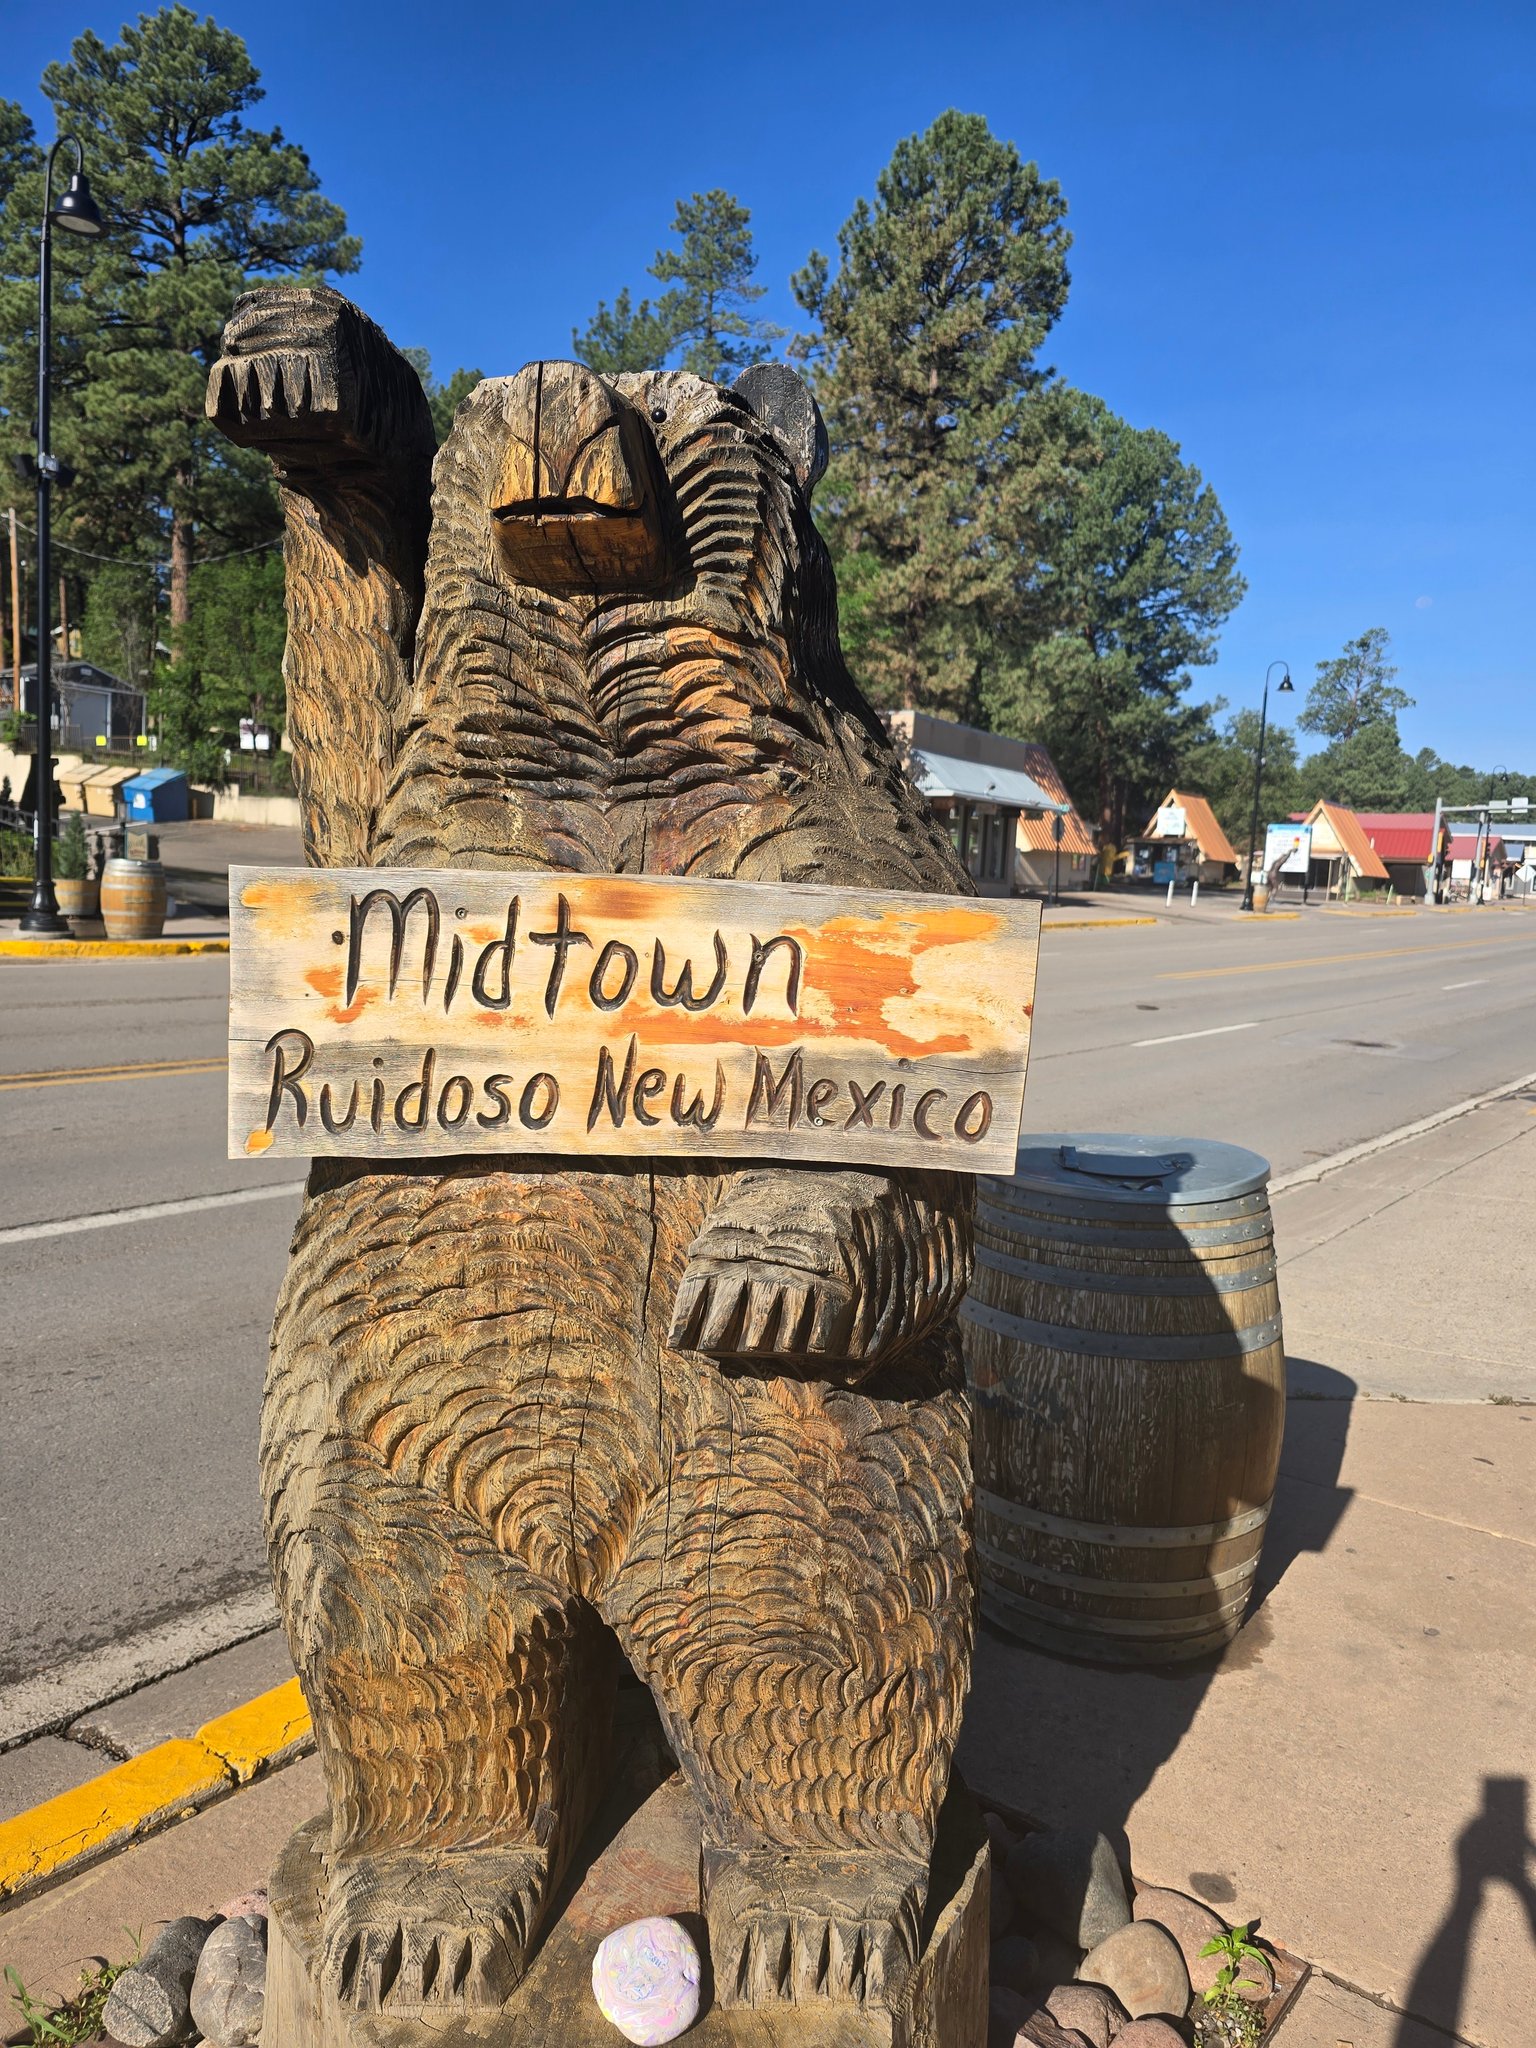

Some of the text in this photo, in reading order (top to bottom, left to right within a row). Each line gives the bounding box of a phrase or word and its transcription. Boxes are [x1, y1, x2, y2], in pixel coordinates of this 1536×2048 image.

[346, 887, 802, 1021] Midtown
[264, 1028, 994, 1145] Ruidoso New Mexico
